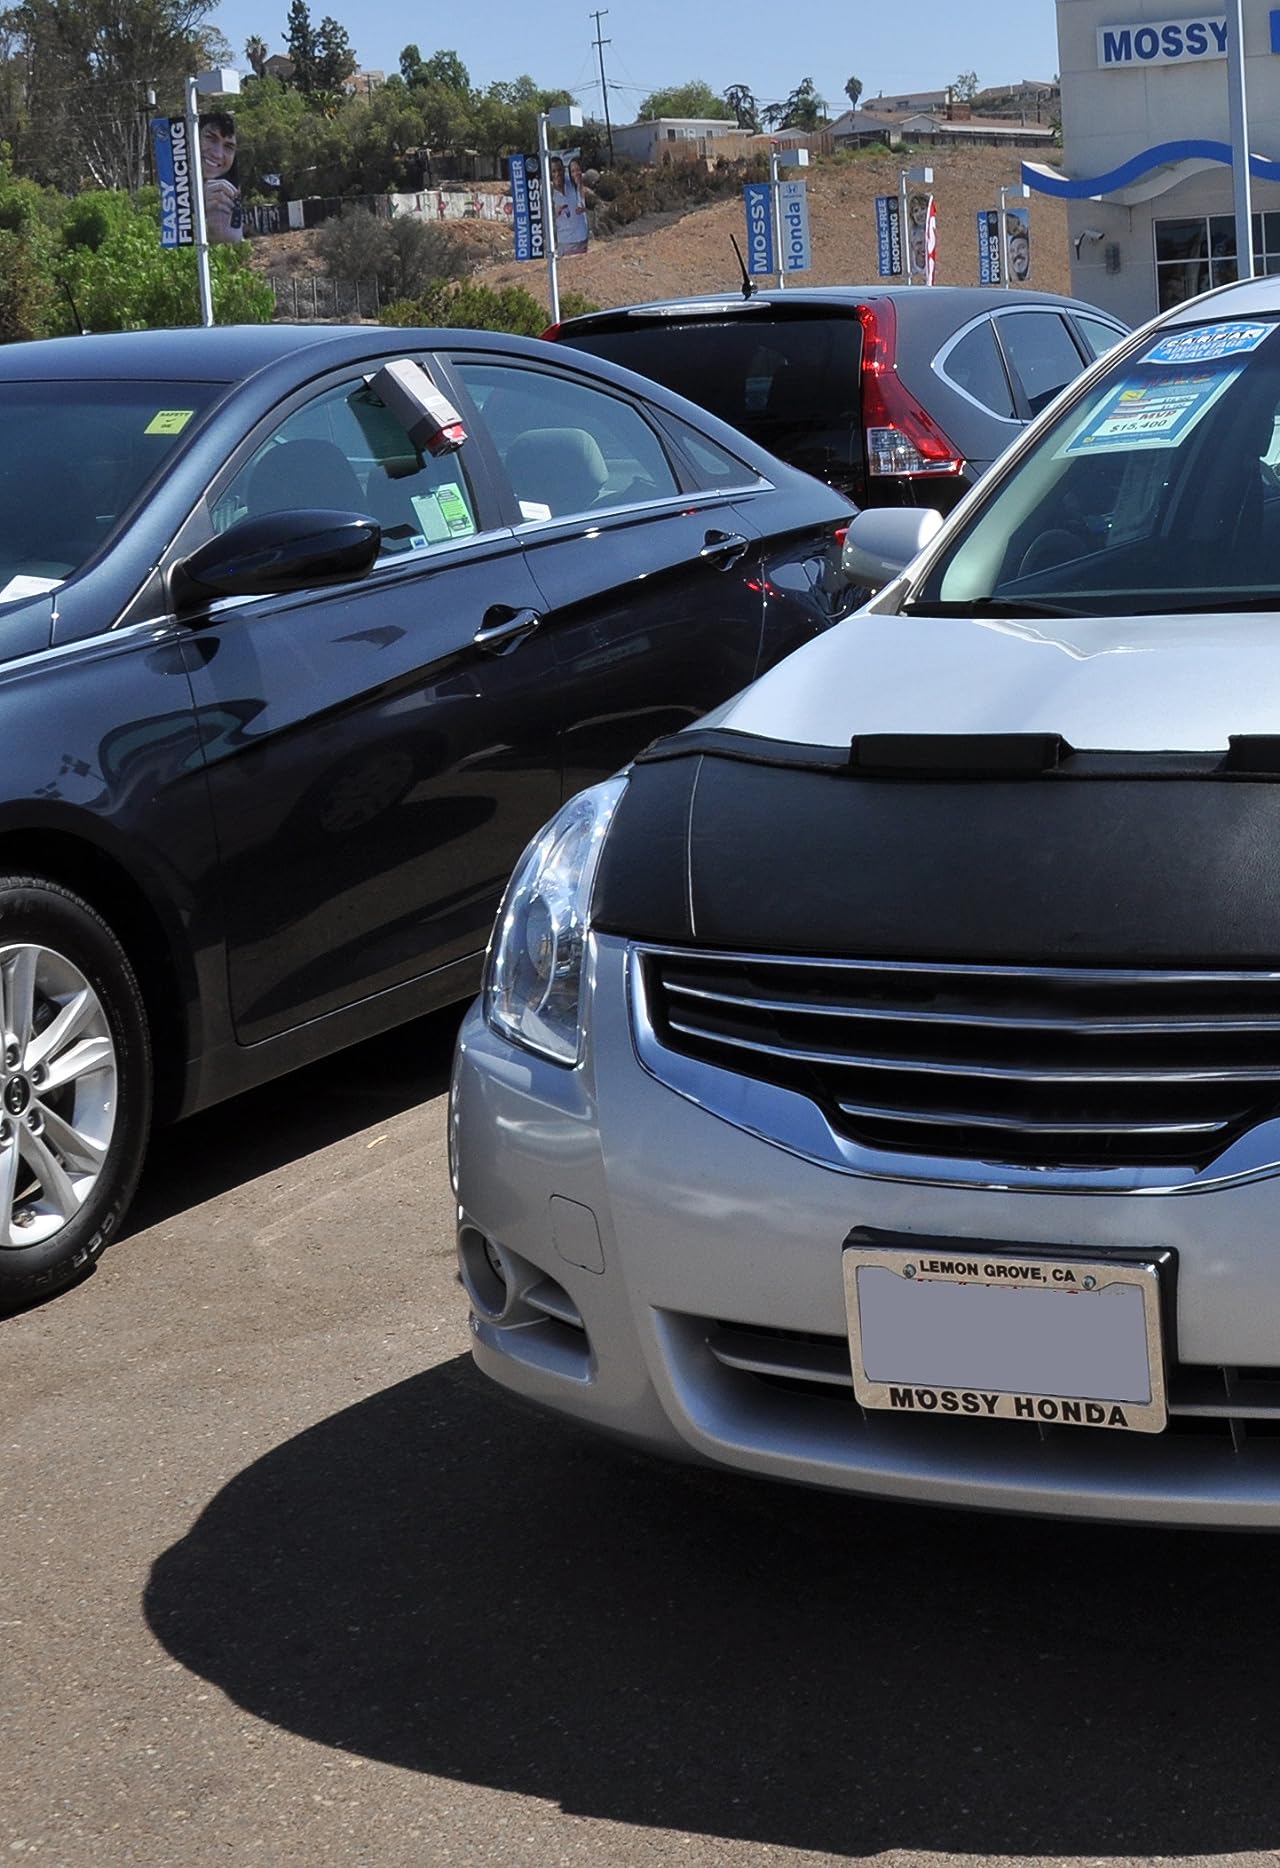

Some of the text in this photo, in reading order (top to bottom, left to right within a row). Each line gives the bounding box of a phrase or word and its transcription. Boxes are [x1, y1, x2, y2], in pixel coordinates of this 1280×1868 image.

[1103, 21, 1227, 63] MOSSY
[160, 180, 177, 244] EASY
[170, 122, 192, 243] FINANCING
[512, 160, 527, 257] DRIVE BETTER
[528, 178, 543, 257] FOR LESS
[749, 189, 768, 272] MOSSY
[784, 202, 804, 270] Honda
[877, 199, 890, 274] HASSLE-FREE
[889, 213, 901, 273] SHOPPING
[979, 218, 990, 283] LOW MOSSY
[989, 235, 1000, 282] PRICES
[1109, 420, 1168, 433] $15,400
[919, 1260, 1076, 1283] LEMON GROVE, CA
[889, 1387, 1129, 1427] MOSSY HONDA
